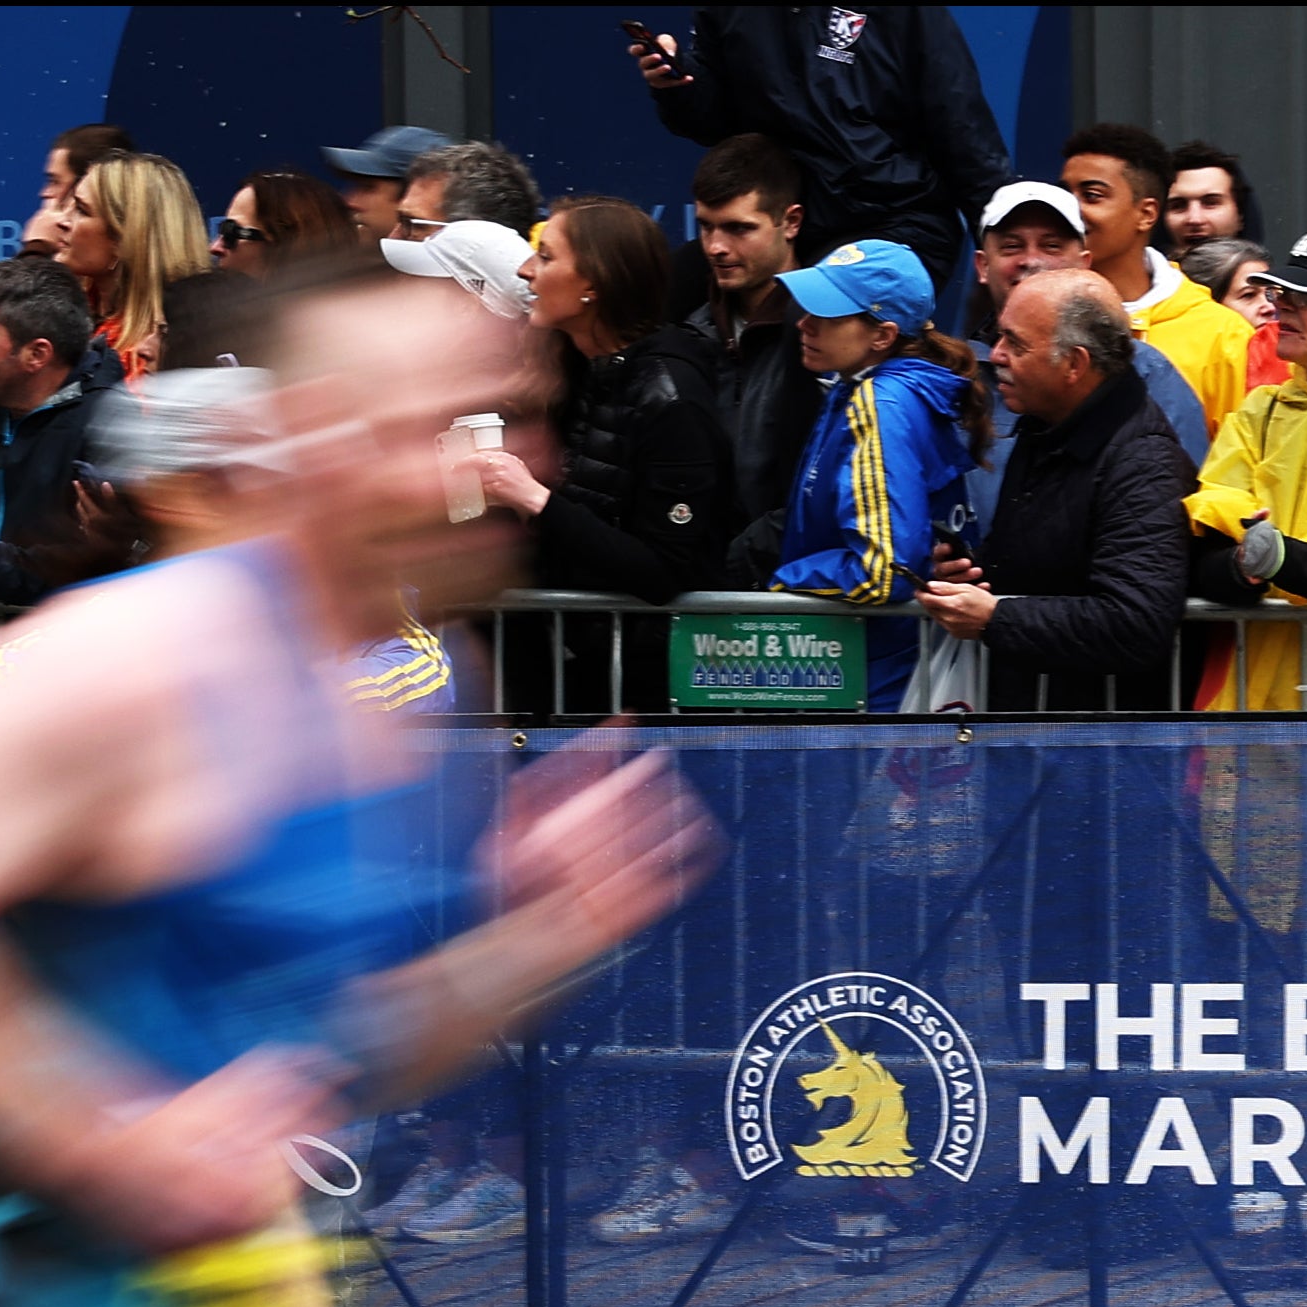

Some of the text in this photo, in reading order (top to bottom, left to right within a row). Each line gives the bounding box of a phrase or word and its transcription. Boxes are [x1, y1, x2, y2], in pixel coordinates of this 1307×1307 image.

[693, 633, 843, 658] Wood & Wire
[695, 673, 753, 686] FENCE
[807, 674, 841, 687] INC
[1020, 982, 1247, 1072] THE
[737, 985, 977, 1166] BOSTON ATHLETIC ASSOCIATION
